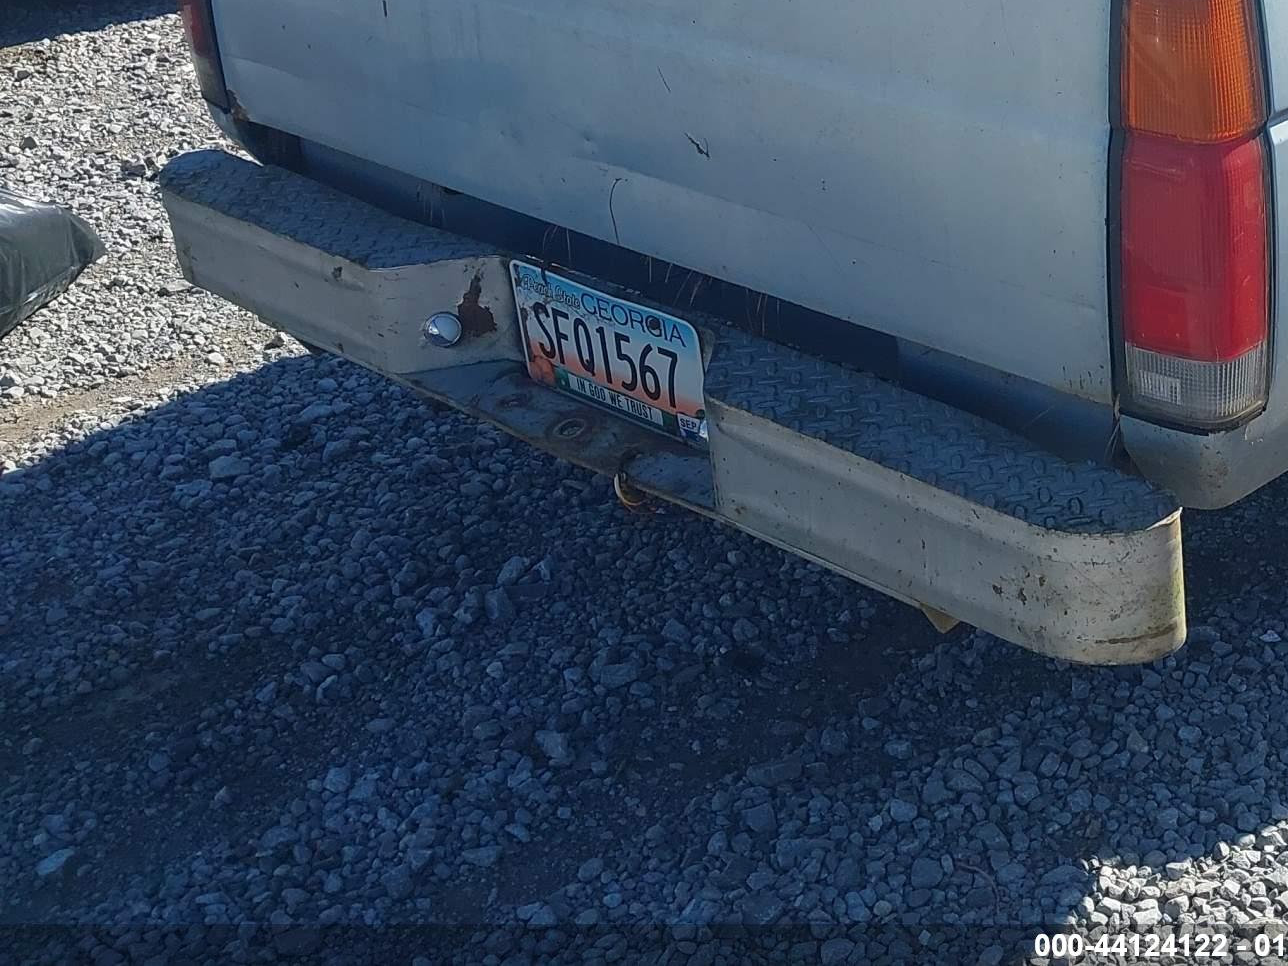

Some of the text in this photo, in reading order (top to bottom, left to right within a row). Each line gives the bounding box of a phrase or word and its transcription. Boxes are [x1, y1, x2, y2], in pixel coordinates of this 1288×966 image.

[580, 292, 687, 348] GEORGIA
[532, 302, 678, 409] SFQ1567
[576, 377, 655, 421] IN GOD WE TRUST
[679, 417, 698, 430] SEP
